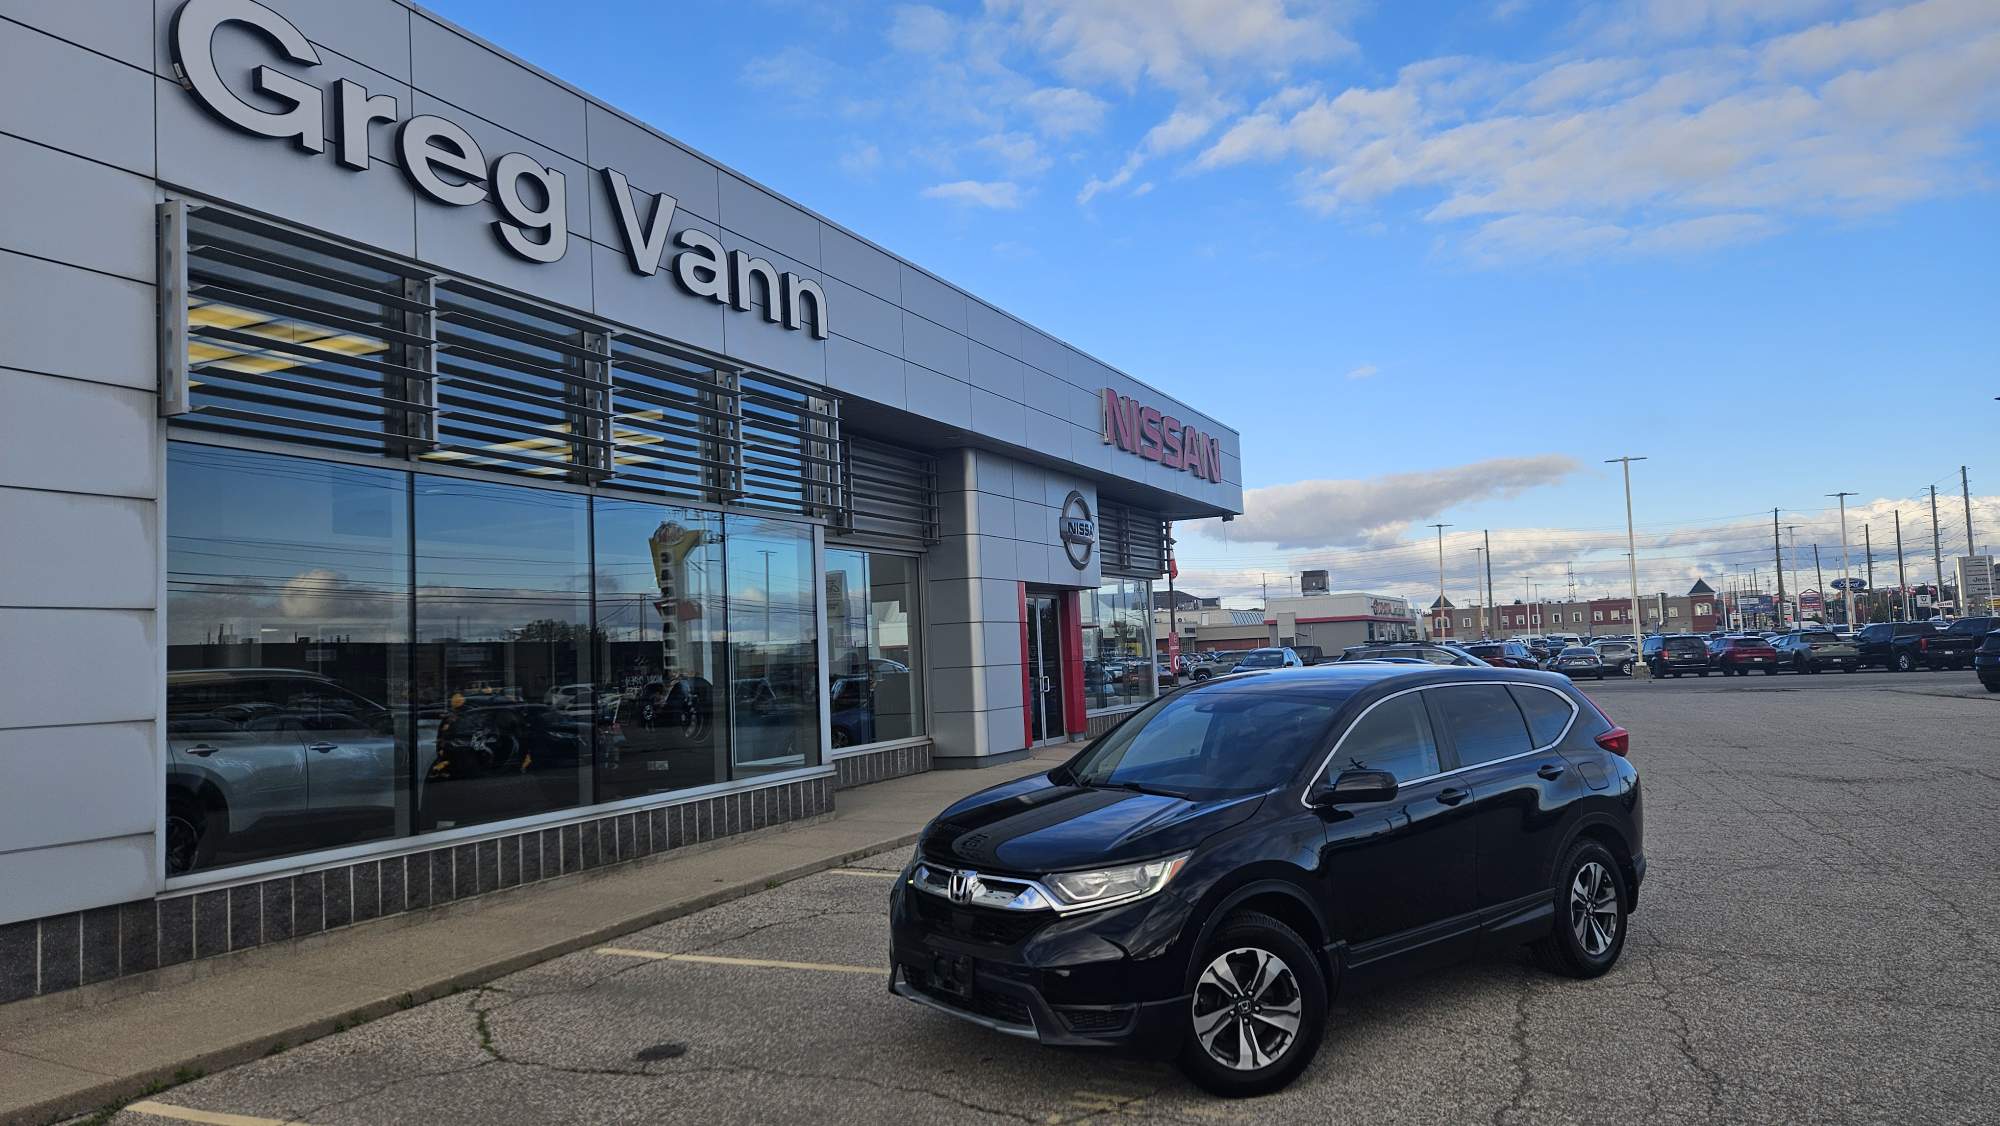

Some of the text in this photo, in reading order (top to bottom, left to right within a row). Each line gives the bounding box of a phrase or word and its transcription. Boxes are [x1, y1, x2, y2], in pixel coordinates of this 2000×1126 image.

[170, 0, 828, 340] Greg Vann
[1101, 387, 1221, 484] NISSAN
[1067, 521, 1094, 536] NISSA
